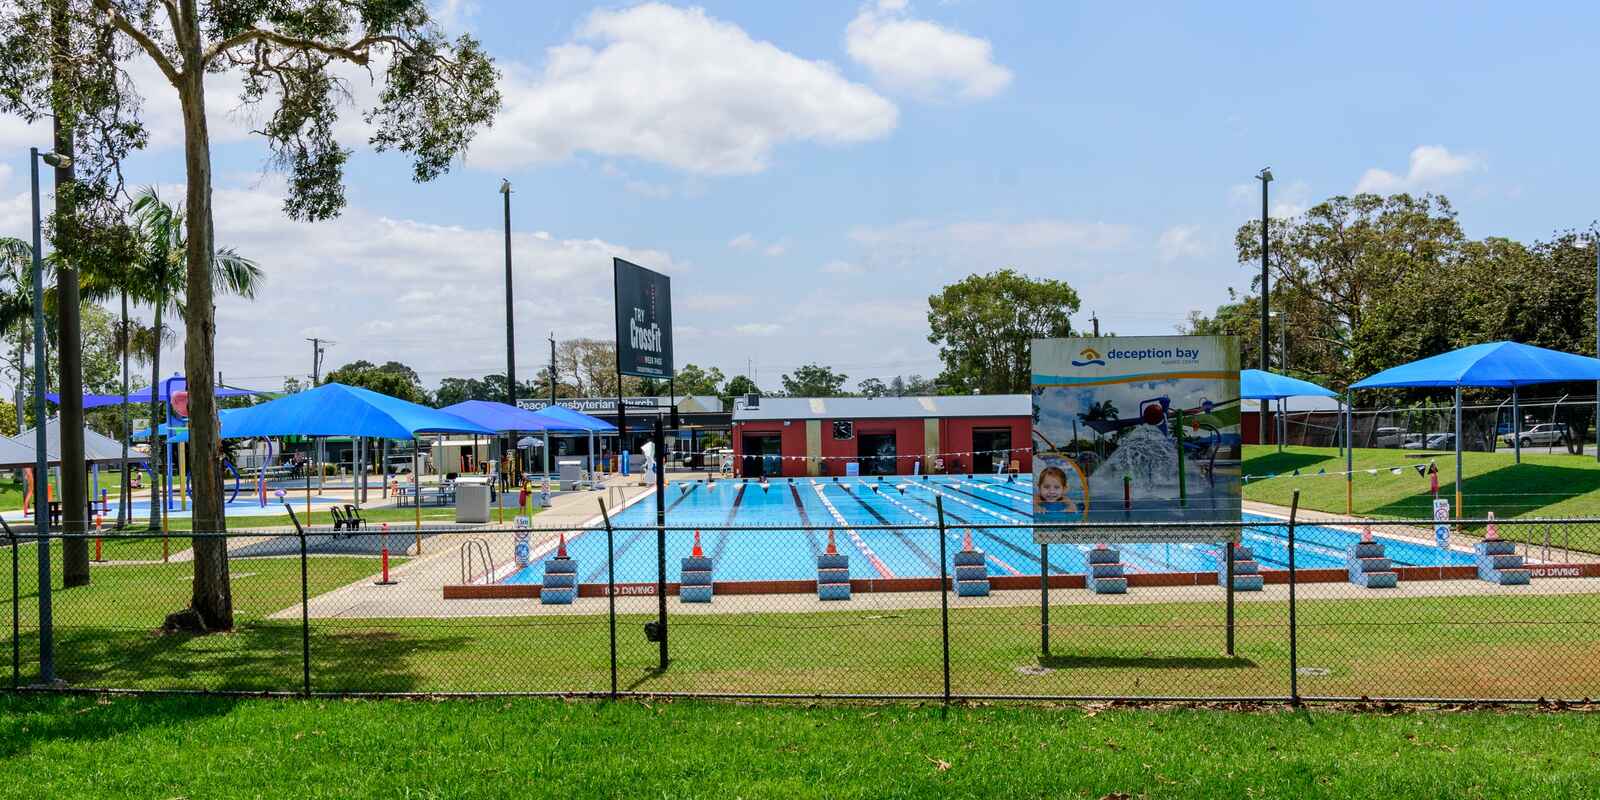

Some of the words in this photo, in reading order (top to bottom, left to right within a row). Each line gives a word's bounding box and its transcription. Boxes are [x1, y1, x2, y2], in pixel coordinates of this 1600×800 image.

[634, 307, 645, 323] TRY
[630, 317, 662, 353] CrossFit
[1107, 347, 1172, 360] deception
[1176, 347, 1200, 359] bay
[516, 400, 547, 410] Peace
[554, 399, 615, 411] resbyterian
[618, 398, 654, 409] hurch
[1531, 568, 1546, 577] NO
[1547, 567, 1580, 577] DIVING
[622, 585, 655, 595] DIVING
